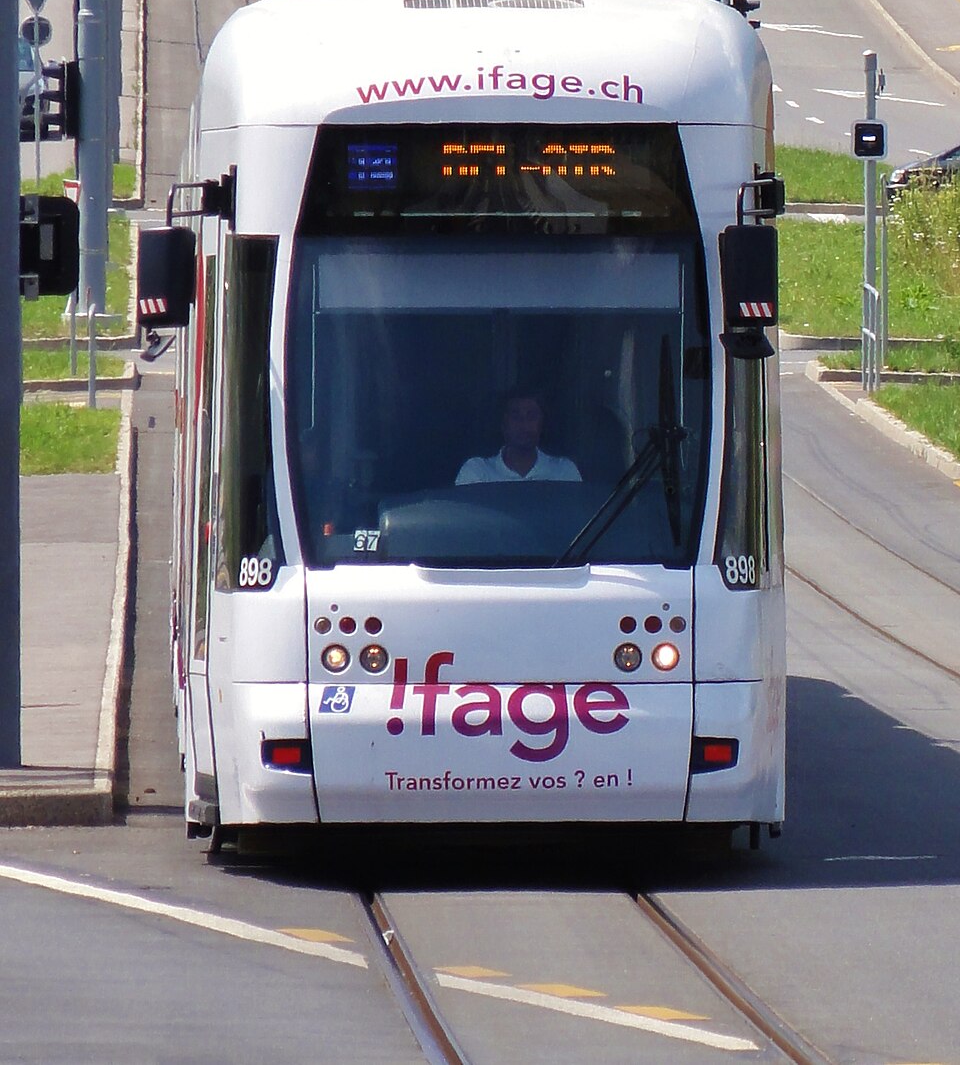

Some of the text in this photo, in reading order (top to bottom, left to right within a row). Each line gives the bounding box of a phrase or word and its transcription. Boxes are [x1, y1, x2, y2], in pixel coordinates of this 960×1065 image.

[356, 65, 644, 104] www.ifage.ch
[354, 533, 380, 550] 67
[239, 557, 272, 586] 898
[725, 555, 755, 584] 898
[385, 771, 522, 791] Transformez
[529, 775, 567, 789] vos
[593, 773, 619, 788] en
